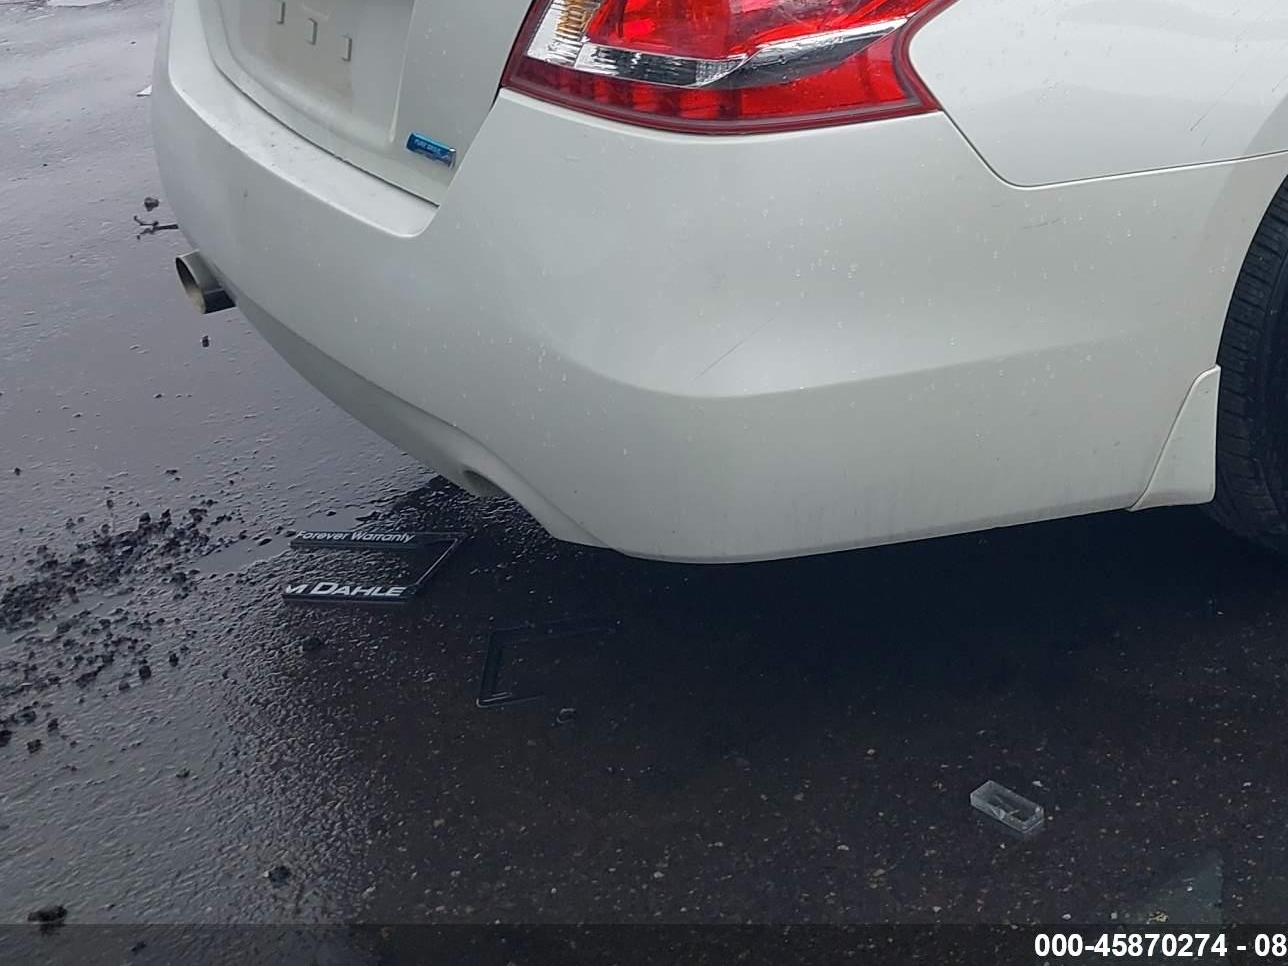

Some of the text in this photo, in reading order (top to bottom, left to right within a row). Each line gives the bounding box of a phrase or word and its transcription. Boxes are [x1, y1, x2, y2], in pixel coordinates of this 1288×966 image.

[295, 530, 416, 544] Forever Warranty
[309, 581, 408, 597] DAHLE
